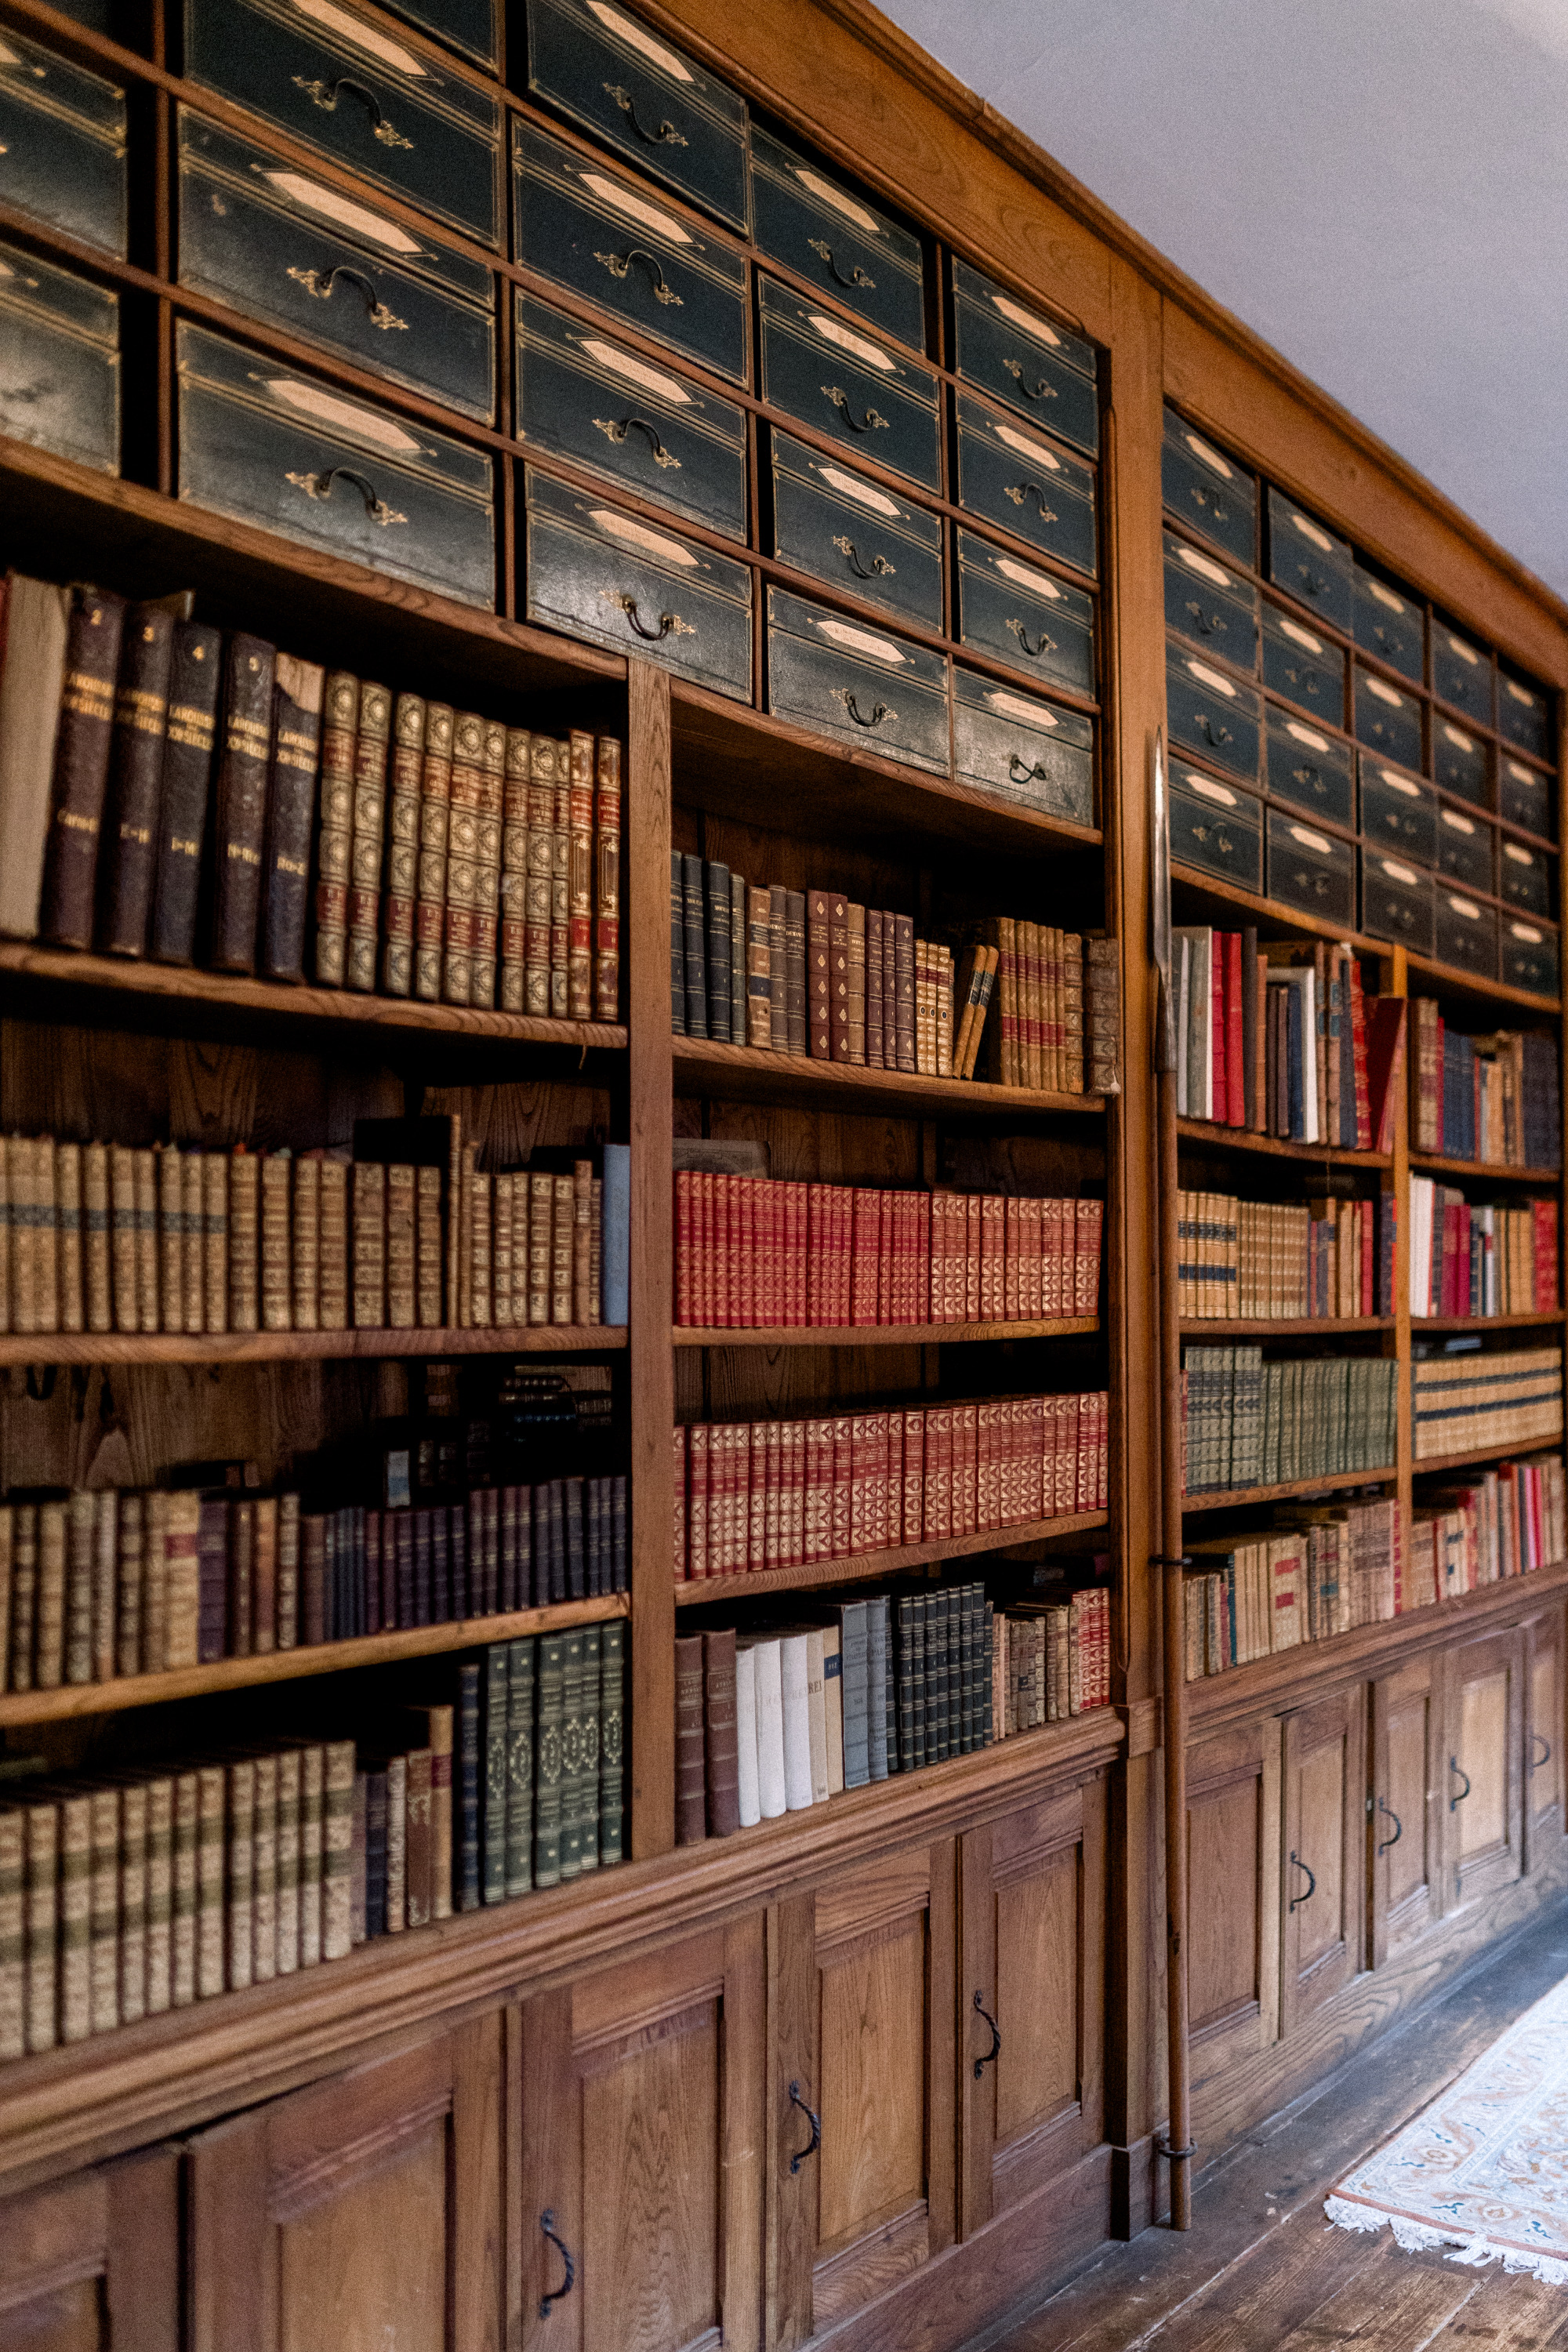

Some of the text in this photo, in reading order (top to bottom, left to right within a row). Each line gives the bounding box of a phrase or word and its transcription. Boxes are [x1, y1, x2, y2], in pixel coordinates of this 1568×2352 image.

[91, 609, 102, 626] 2
[143, 626, 155, 642] 3
[192, 646, 205, 661] 4
[249, 656, 260, 672] 5
